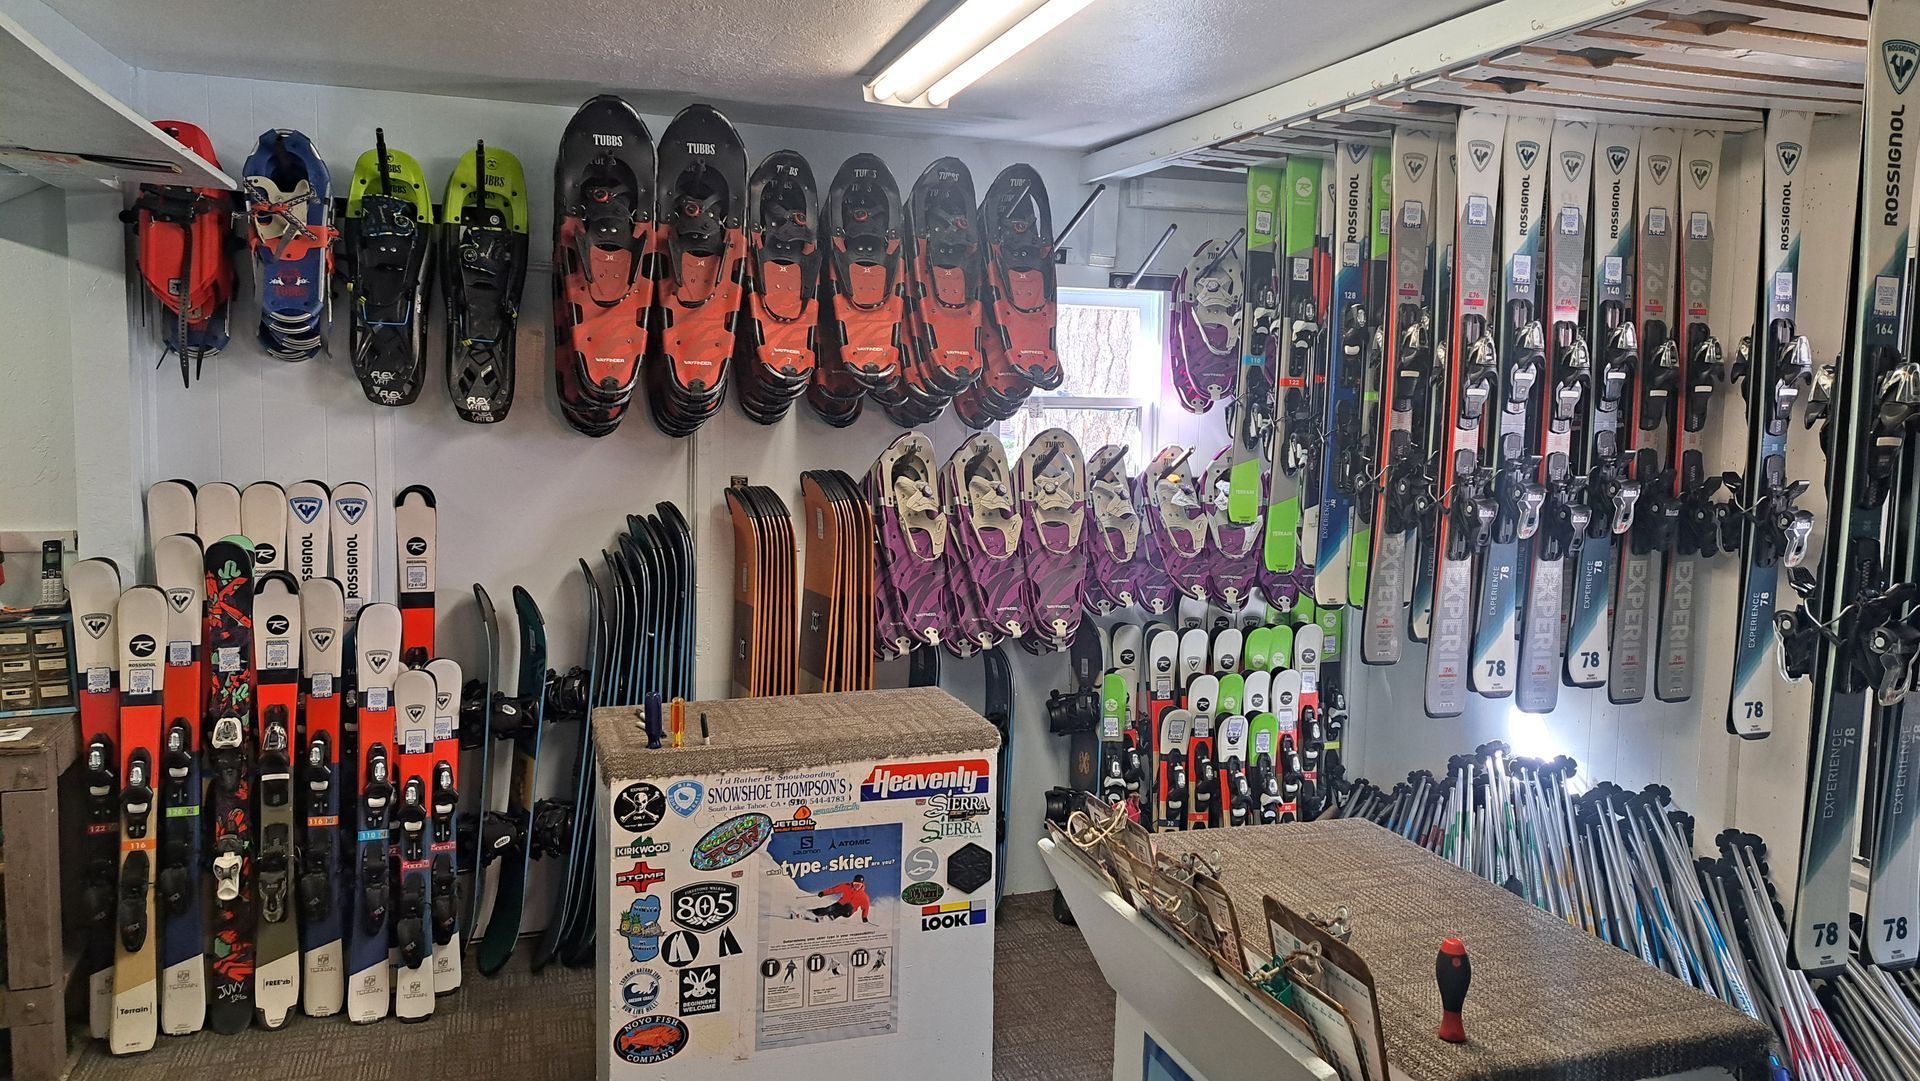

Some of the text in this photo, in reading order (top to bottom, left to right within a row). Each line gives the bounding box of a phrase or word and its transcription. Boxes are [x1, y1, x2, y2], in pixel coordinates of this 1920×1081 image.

[1887, 44, 1918, 56] ROSSIGNOL
[593, 134, 623, 147] TUBBS
[687, 142, 715, 155] TUBBS
[1884, 104, 1905, 226] ROSSIGNOL
[1347, 174, 1359, 243] ROSSIGNOL
[1519, 174, 1530, 236] ROSSIGNOL
[1611, 179, 1621, 239] ROSSIGNOL
[1779, 181, 1791, 251] ROSSIGNOL
[1344, 291, 1356, 299] 128
[1515, 284, 1528, 293] 140
[1607, 286, 1619, 295] 140
[1776, 303, 1790, 313] 148
[1875, 322, 1893, 335] 164
[1288, 378, 1299, 386] 122
[1322, 498, 1336, 539] EXPERIENCE JR
[302, 532, 313, 582] SSIGNOL
[347, 533, 358, 598] ROSSIGNOL
[1489, 565, 1510, 616] EXPERIENCE 78
[1584, 560, 1603, 609] EXPERIENCE 78
[1748, 592, 1769, 648] EXPERIENCE 78
[1581, 652, 1600, 668] 78
[1486, 660, 1506, 678] 78
[1744, 701, 1763, 718] 78
[1823, 727, 1856, 819] EXPERIENCE 78
[1894, 724, 1913, 815] EXPERIENCE
[734, 776, 762, 784] Rather
[872, 766, 978, 798] Heavenly
[708, 778, 847, 804] SNOWSHOE THOMPSON'S
[809, 796, 845, 805] 544-4783
[923, 794, 991, 818] SIERRA
[773, 818, 816, 828] JETBOIL
[920, 820, 981, 843] SIERRA
[616, 844, 669, 856] KIRKWOOD
[838, 839, 871, 847] ATOMIC
[781, 860, 821, 878] type
[829, 853, 872, 872] skier
[618, 871, 664, 882] STOMP
[676, 892, 733, 920] 805
[922, 913, 968, 931] LOOK
[1884, 916, 1908, 942] 78
[1813, 922, 1838, 947] 78
[217, 982, 244, 999] JUVY
[120, 1006, 149, 1015] Terrain
[683, 999, 717, 1007] BEGINNERS
[683, 1004, 717, 1013] WELCOME
[624, 1016, 680, 1032] NOYO FISH
[626, 1049, 676, 1063] COMPANY
